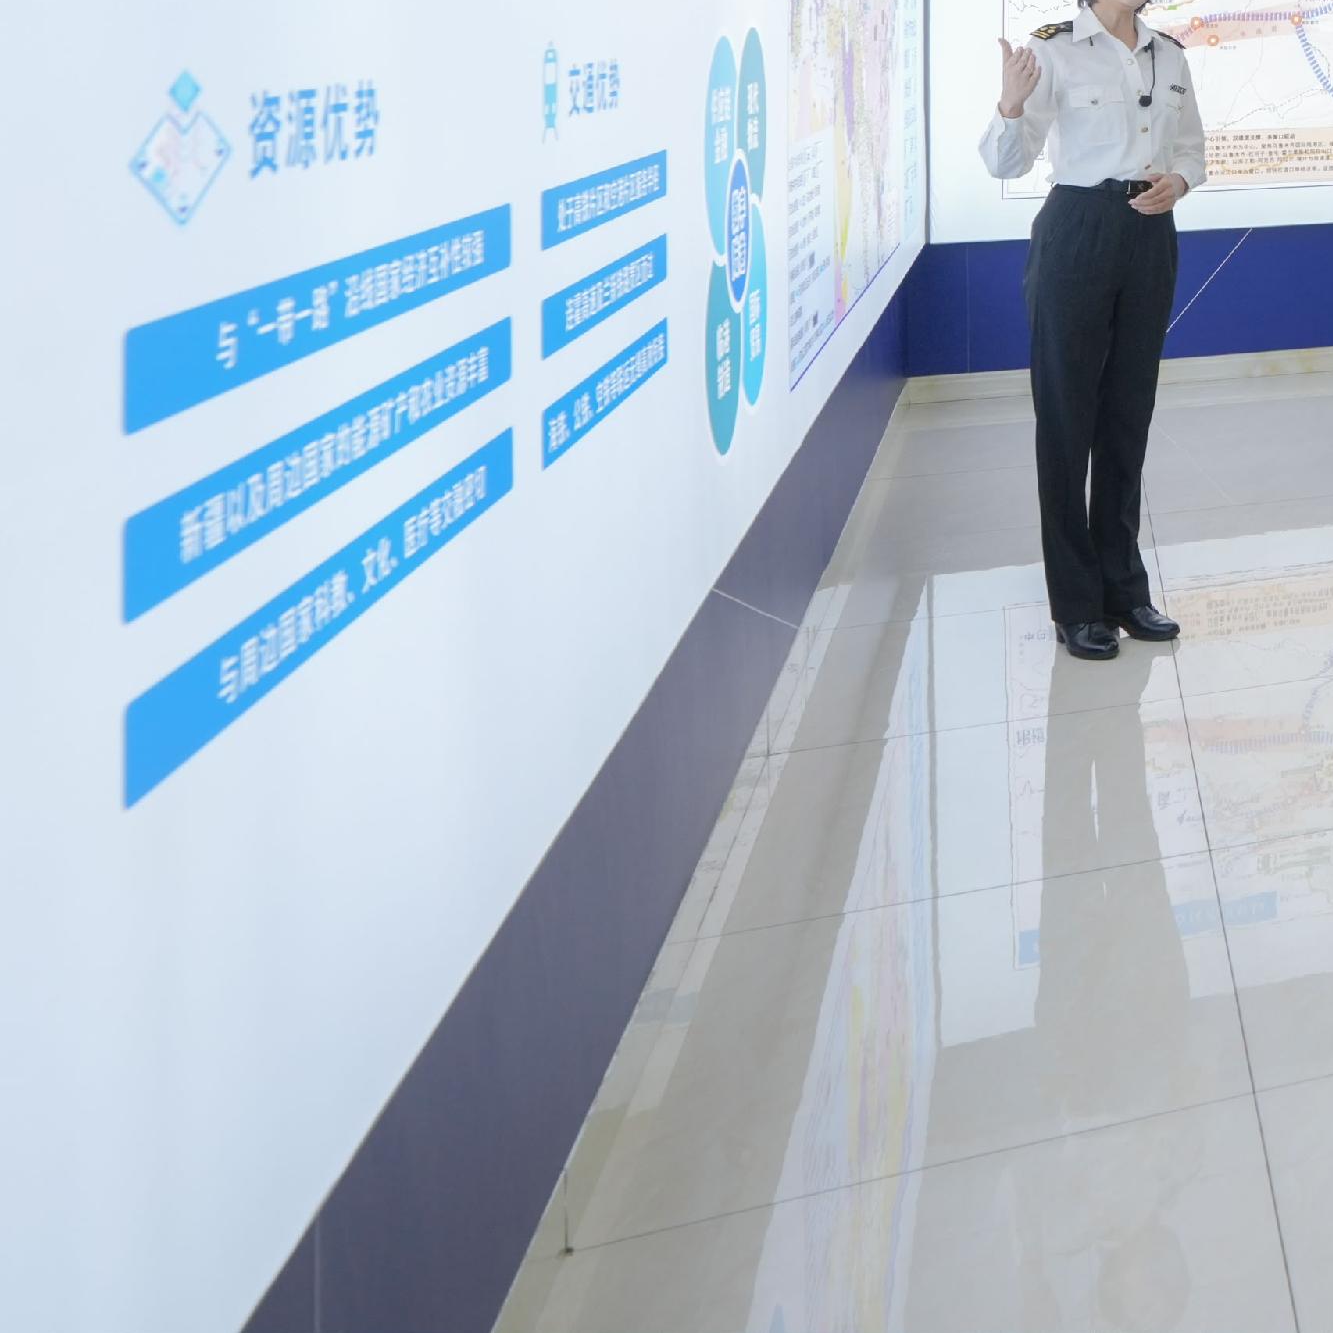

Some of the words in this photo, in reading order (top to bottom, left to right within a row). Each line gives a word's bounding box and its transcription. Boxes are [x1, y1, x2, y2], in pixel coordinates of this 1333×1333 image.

[568, 58, 621, 118] 交通优势
[248, 78, 380, 180] 资源优势
